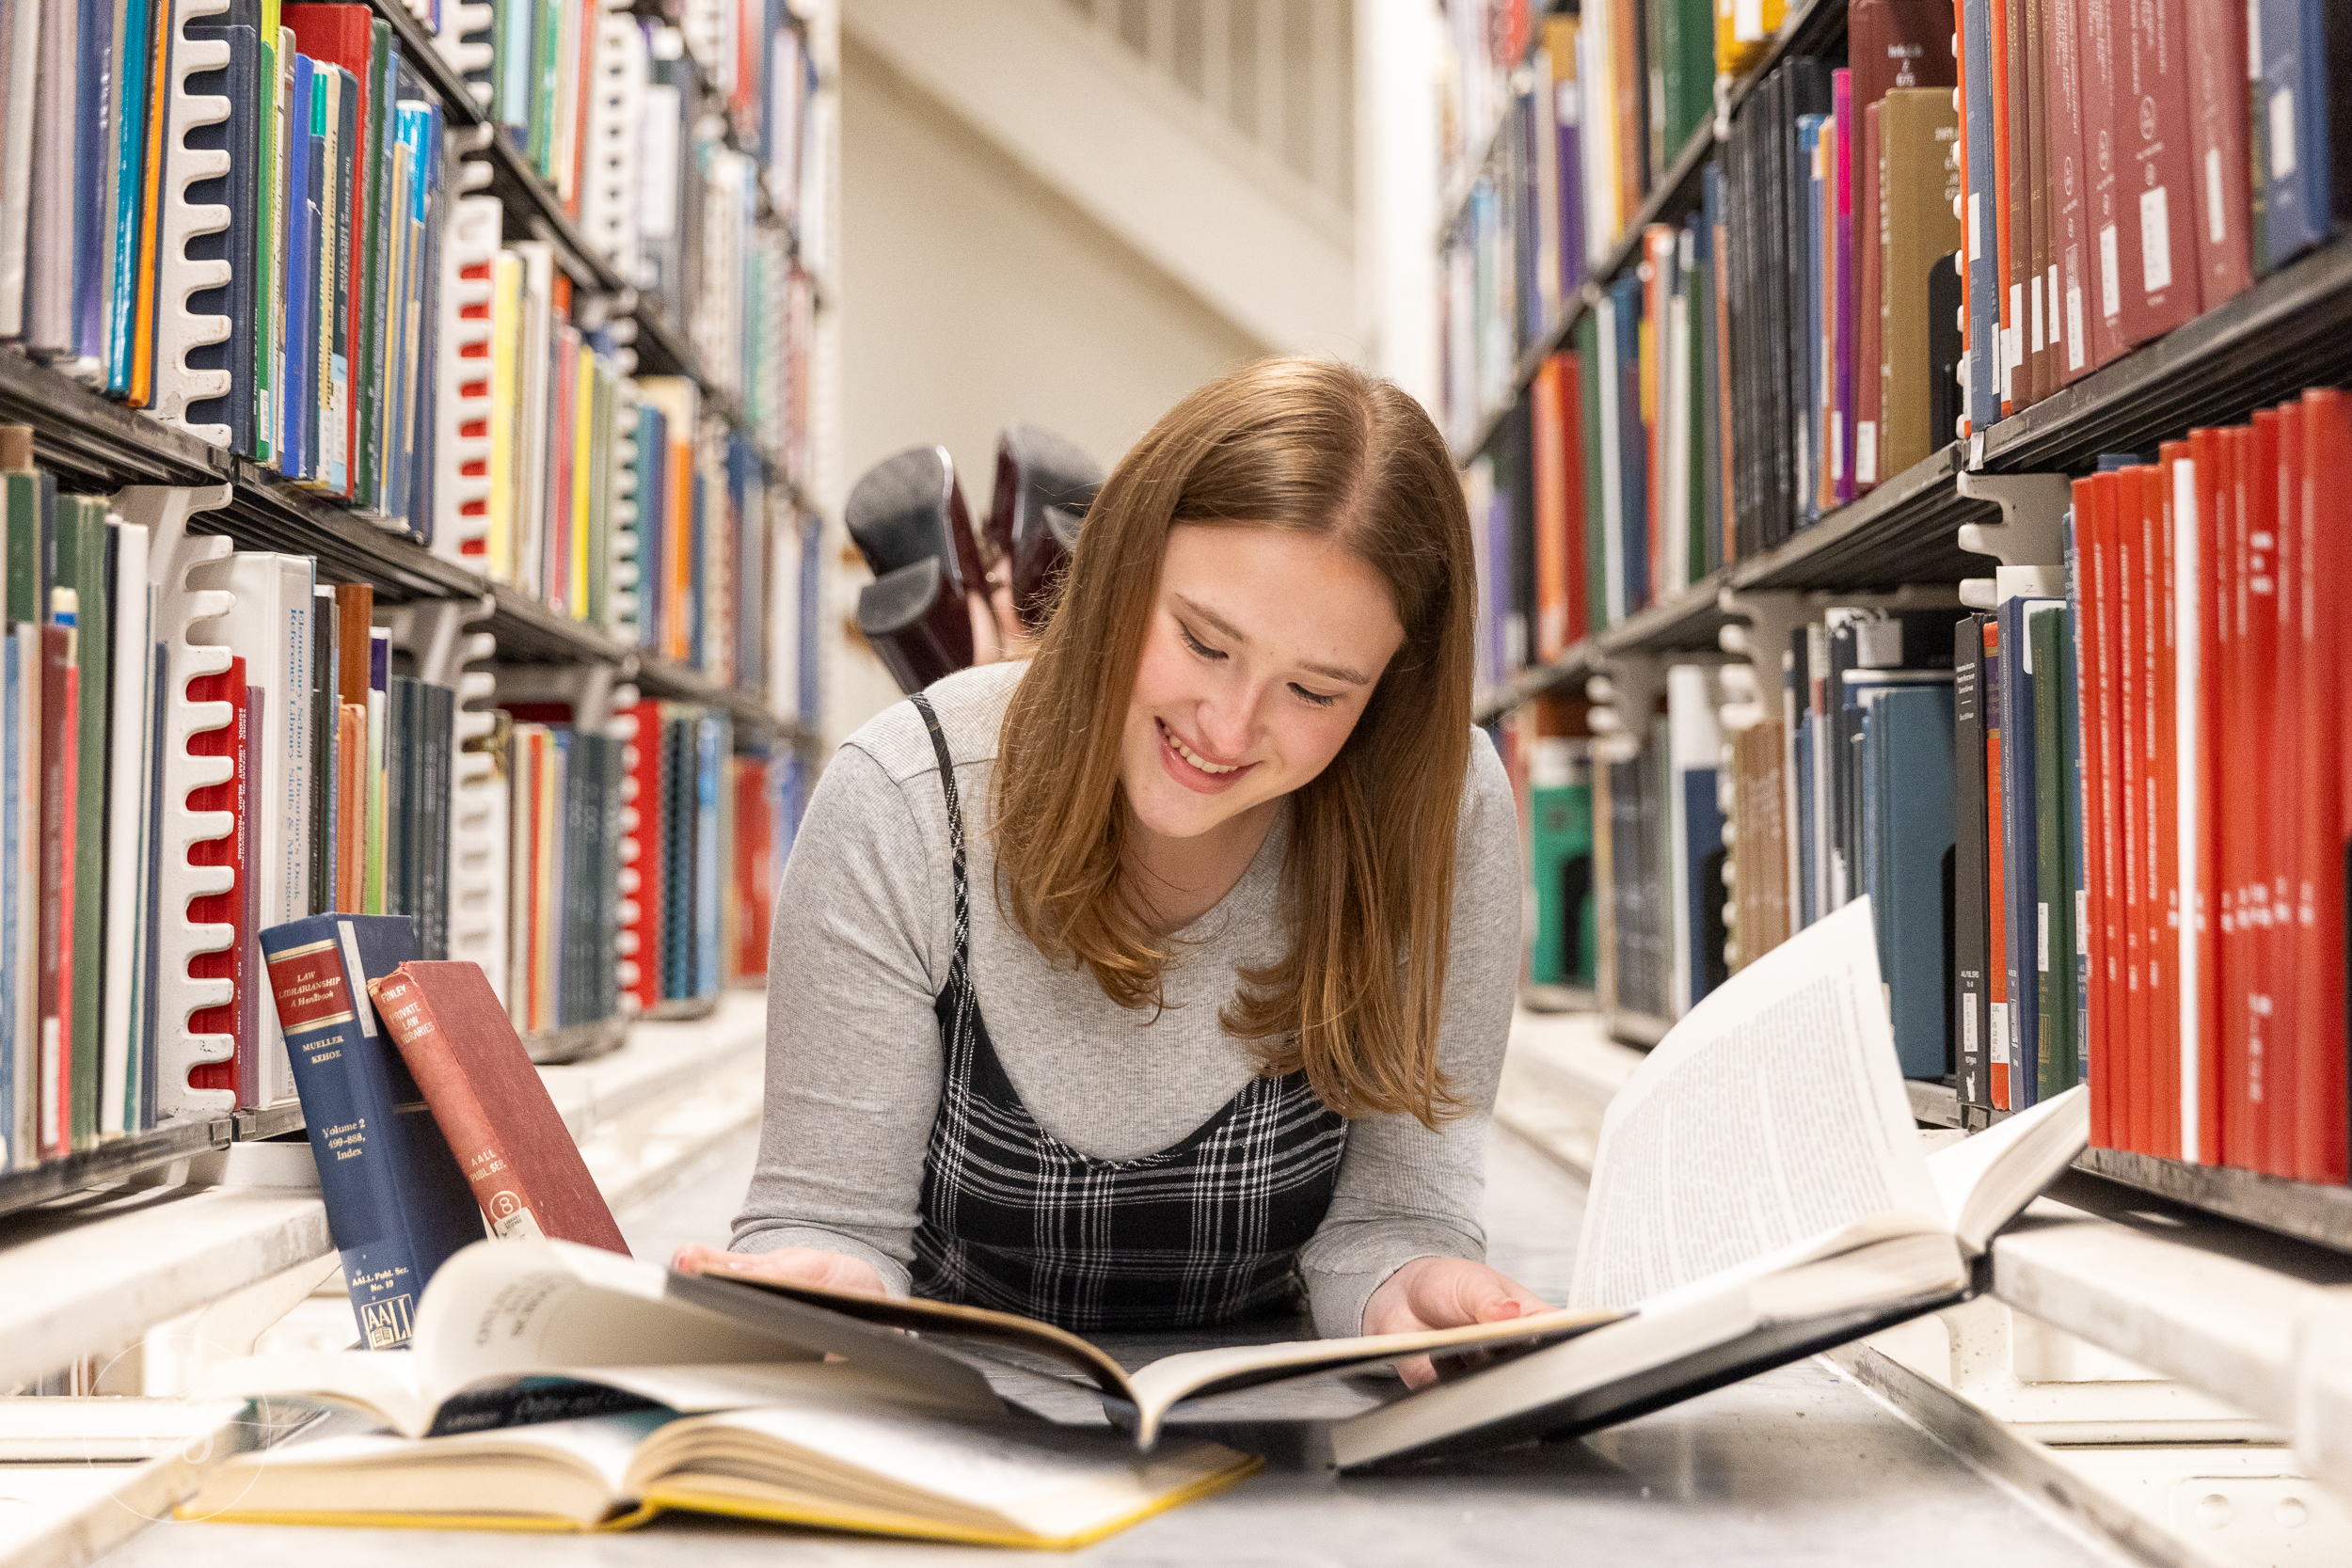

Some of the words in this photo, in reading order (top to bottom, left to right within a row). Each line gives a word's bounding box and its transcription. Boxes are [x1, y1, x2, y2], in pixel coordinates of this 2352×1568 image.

[296, 971, 316, 983] LAW
[278, 976, 342, 999] LIBRARIANSHIP
[380, 984, 406, 1004] FINLEY
[298, 990, 334, 1006] Handbook
[389, 1002, 421, 1024] PRIVATE
[402, 1016, 420, 1031] LAW
[400, 1022, 436, 1047] IBRARIES
[303, 1036, 344, 1052] MUELLER
[311, 1050, 342, 1064] KEHOE
[322, 1123, 358, 1139] Volume
[358, 1118, 366, 1129] 2
[336, 1148, 363, 1161] Index
[499, 1196, 514, 1214] 8
[374, 1269, 394, 1281] Publ.
[394, 1267, 409, 1275] Ser.
[370, 1283, 384, 1292] No.
[385, 1279, 394, 1289] 19
